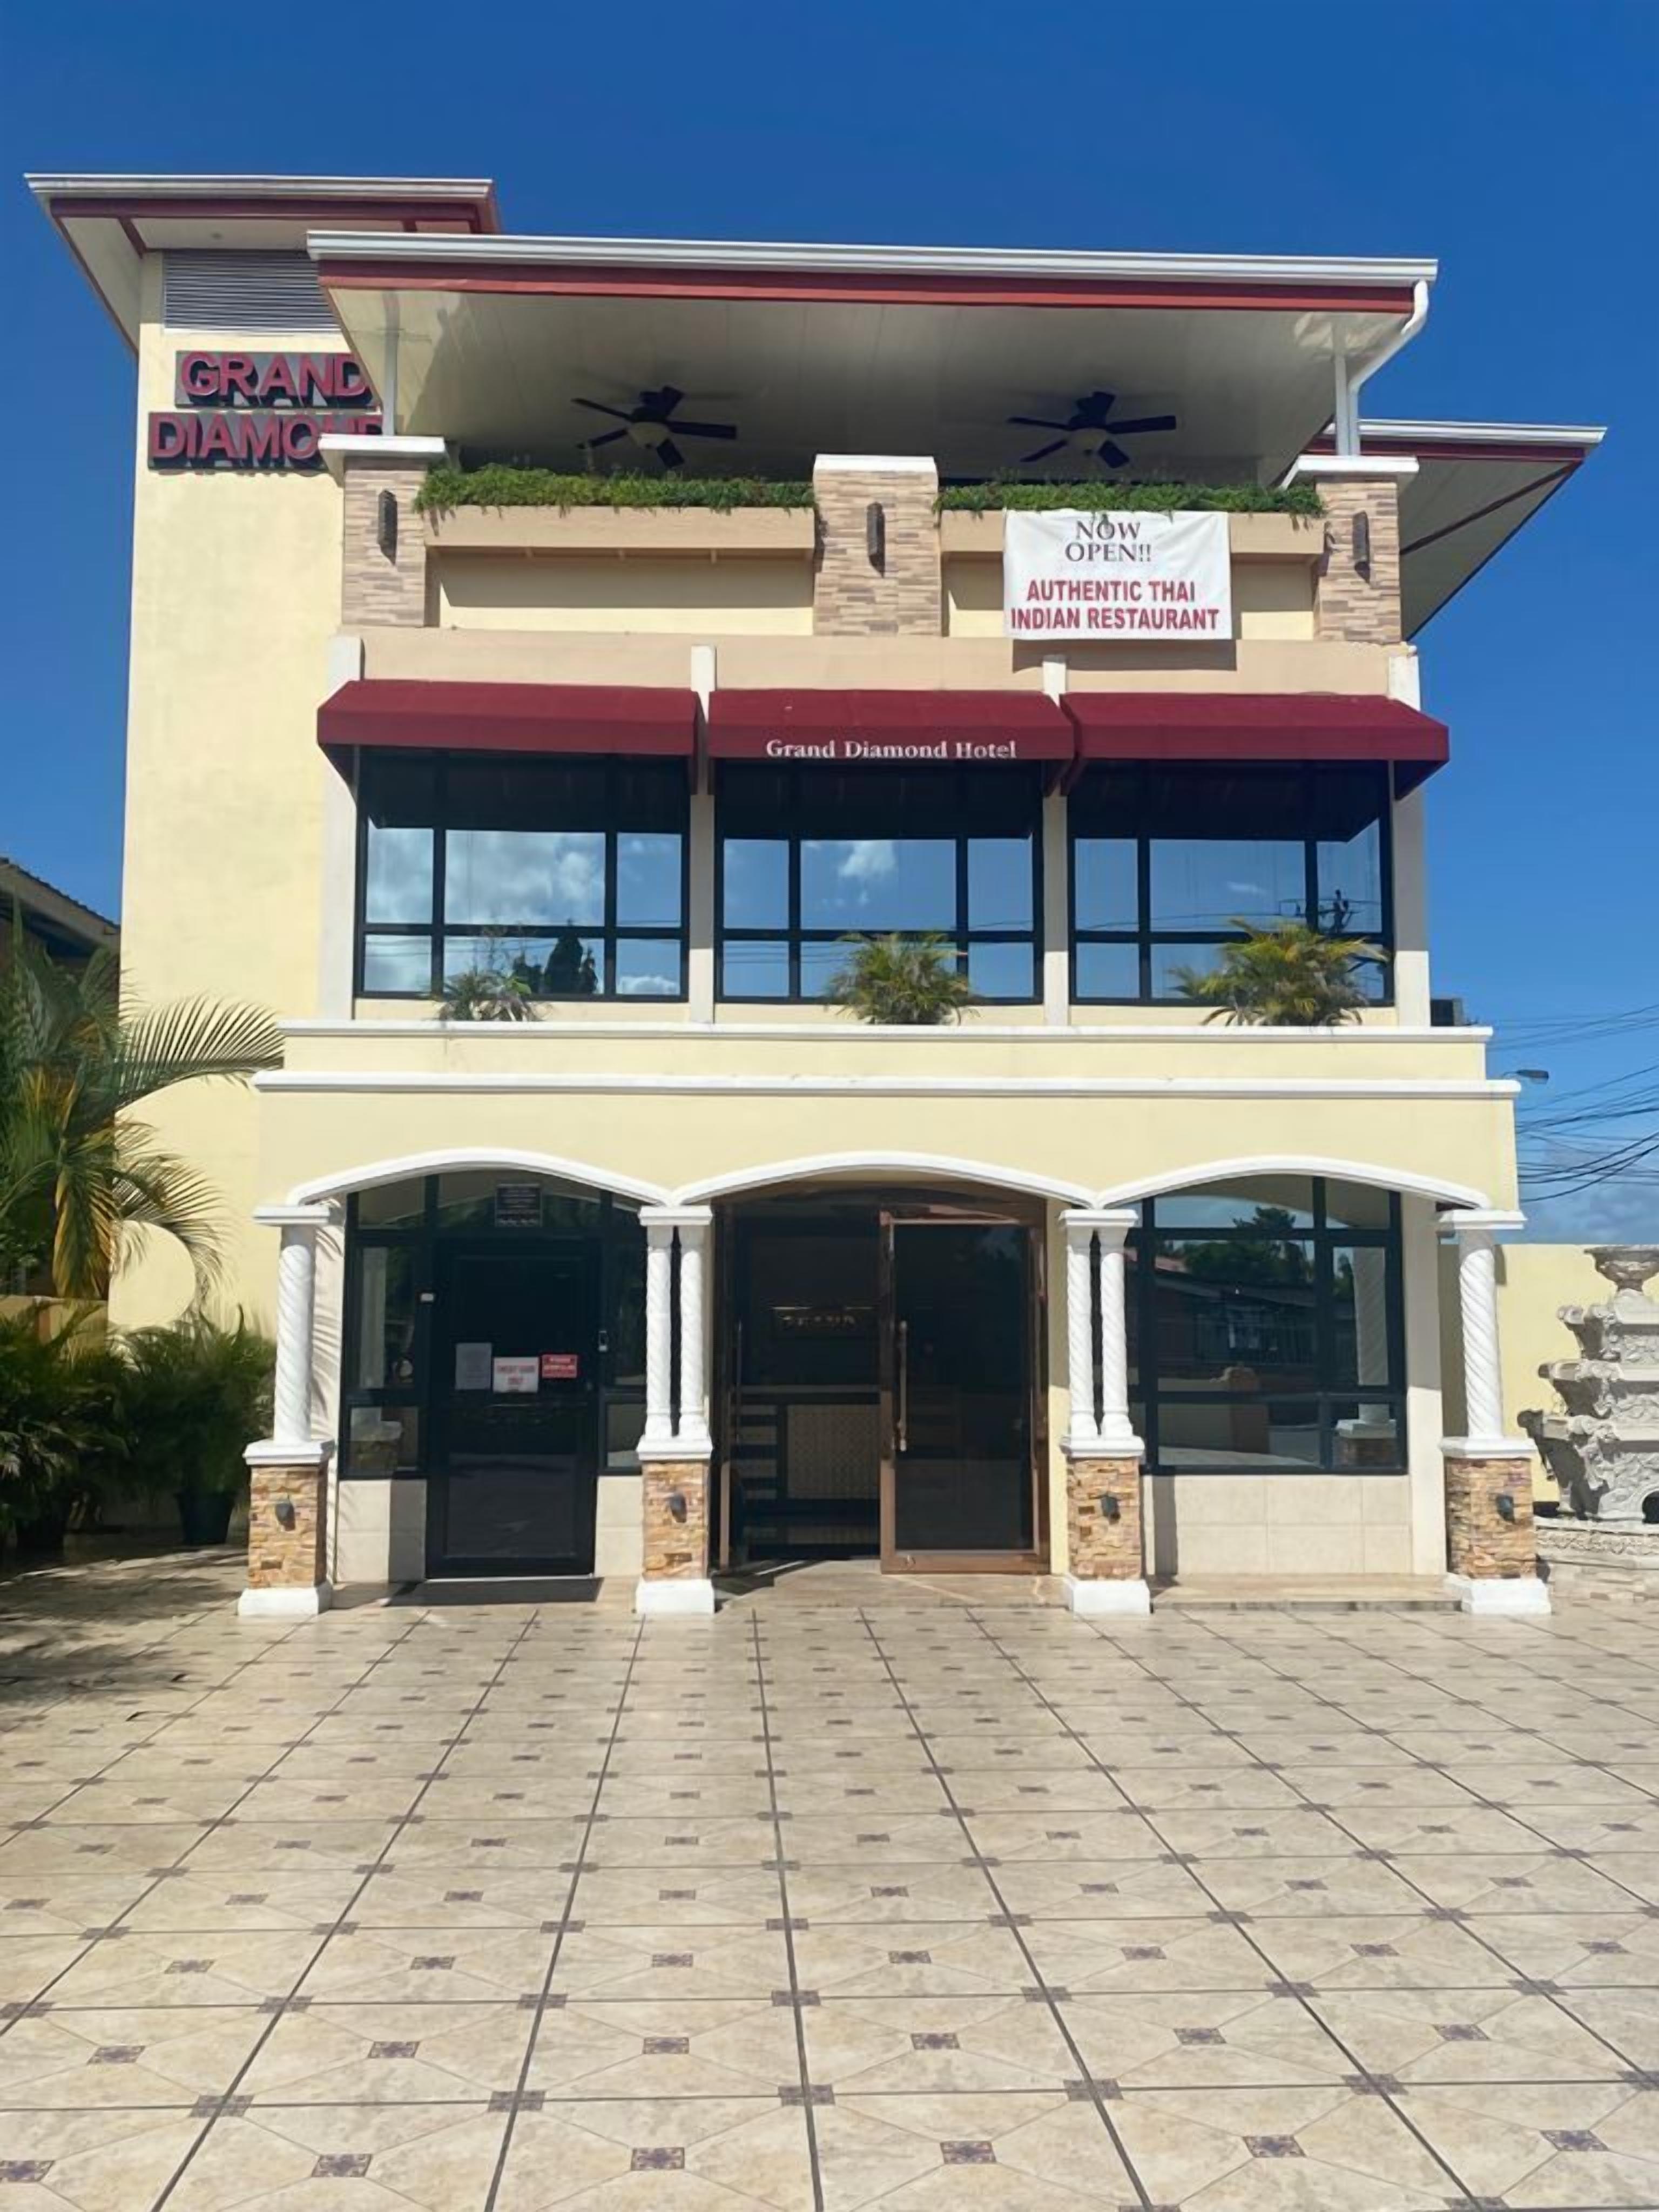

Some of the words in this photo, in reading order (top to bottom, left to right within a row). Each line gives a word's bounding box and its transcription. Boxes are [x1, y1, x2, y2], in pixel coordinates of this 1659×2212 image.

[182, 352, 369, 397] GRAND
[152, 414, 382, 459] DIAMO
[1076, 521, 1140, 539] NOW
[1065, 543, 1151, 562] OPEN!!
[1027, 580, 1141, 601] AUTHENTIC
[1149, 581, 1195, 602] THAI
[1011, 608, 1079, 629] INDIAN
[1088, 609, 1219, 630] RESTAURANT
[766, 739, 835, 758] Grand
[844, 741, 948, 758] Diamond
[956, 741, 1016, 758] Hotel
